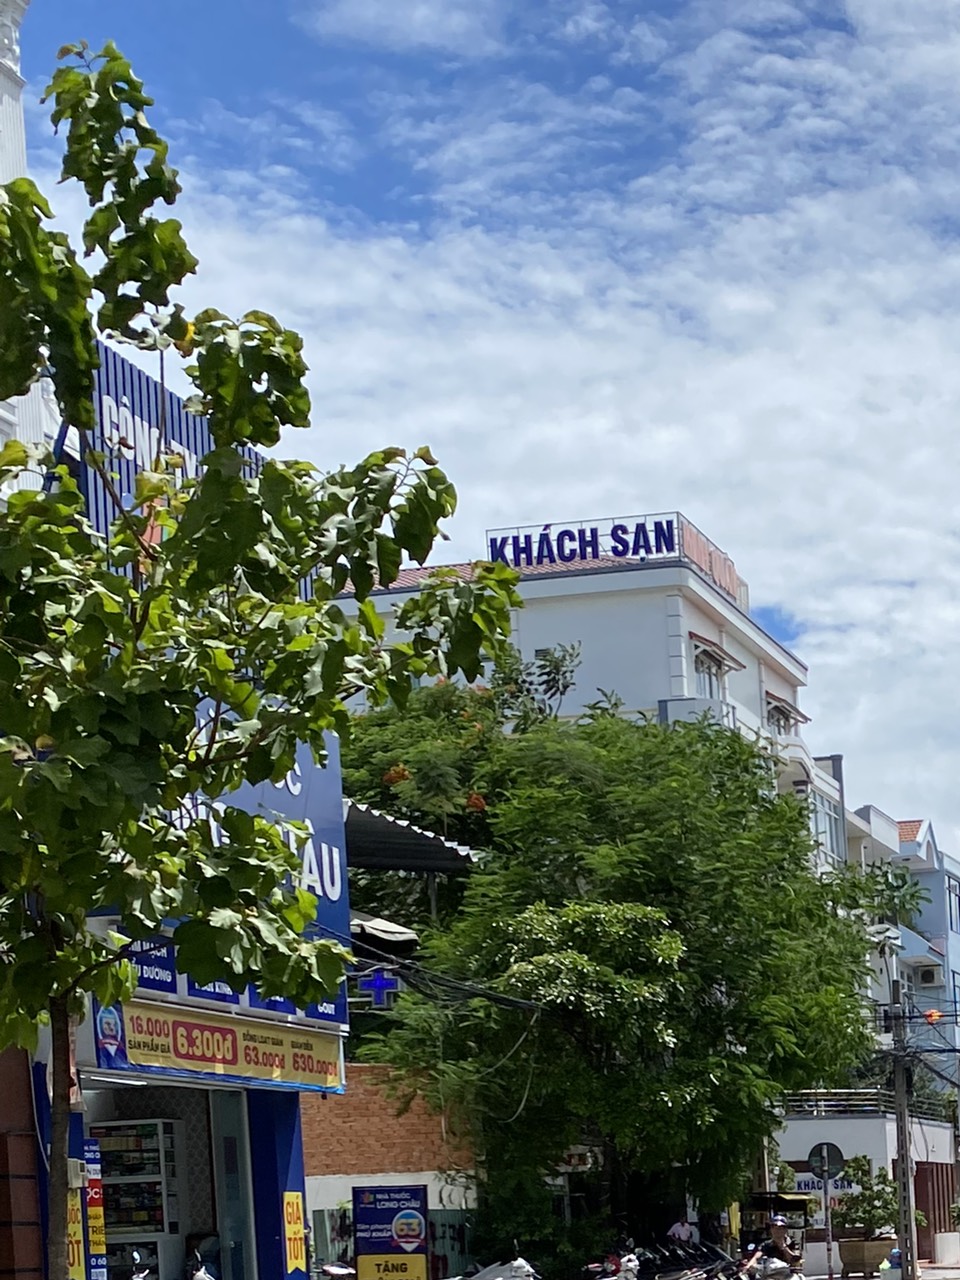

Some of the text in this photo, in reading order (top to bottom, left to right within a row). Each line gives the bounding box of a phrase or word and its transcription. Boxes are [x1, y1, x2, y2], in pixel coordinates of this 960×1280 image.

[489, 524, 600, 568] KHÁCH
[610, 519, 676, 563] SẠN
[374, 1260, 408, 1276] TẶNG
